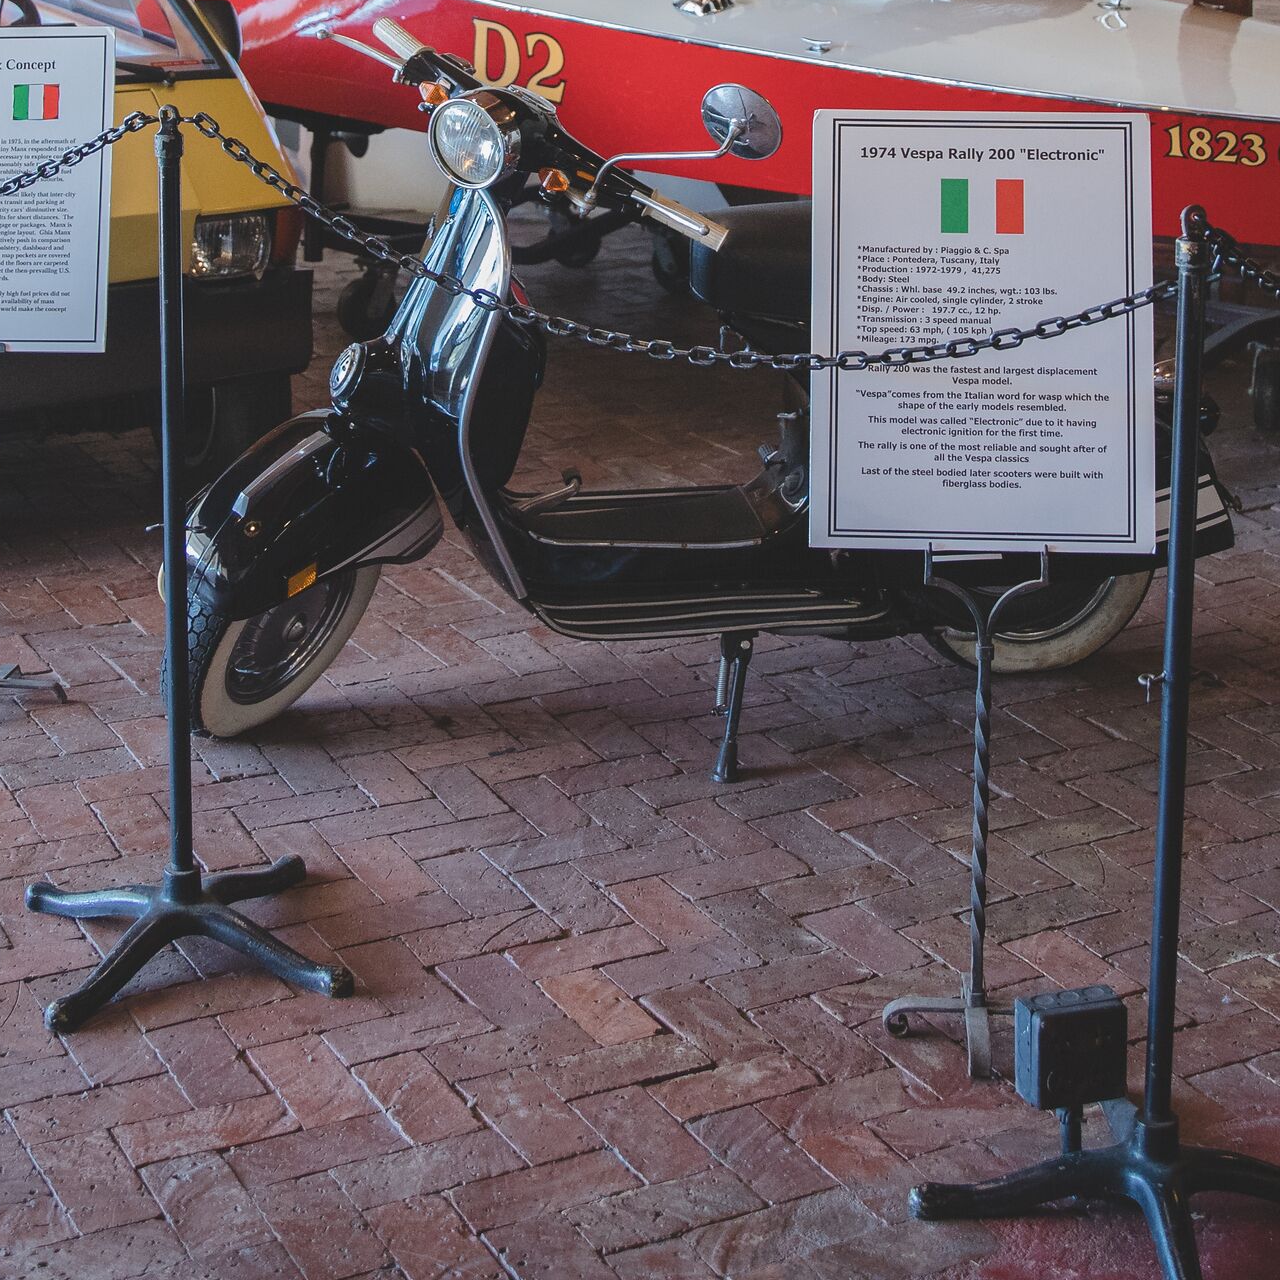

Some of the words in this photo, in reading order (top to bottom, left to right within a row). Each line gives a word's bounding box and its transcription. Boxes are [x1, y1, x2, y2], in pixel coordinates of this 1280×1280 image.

[472, 16, 567, 104] D2
[6, 59, 56, 72] Concept
[1165, 123, 1267, 167] 1823
[860, 147, 897, 158] 1974
[900, 148, 943, 161] Vespa
[948, 148, 984, 162] Rally
[988, 149, 1015, 159] 200
[1020, 149, 1105, 160] "Electronic"
[922, 247, 934, 255] by
[940, 247, 973, 255] Piaggio
[993, 248, 1010, 256] Spa
[892, 256, 938, 264] Pontedera,
[940, 257, 978, 265] Tuscany,
[979, 257, 1000, 265] Italy
[971, 267, 1001, 275] 41,275
[968, 287, 998, 295] inches,
[999, 288, 1022, 296] wgt.:
[909, 296, 940, 304] cooled,
[942, 296, 968, 305] single
[969, 297, 1006, 305] cylinder,
[987, 307, 1001, 315] hp.
[932, 317, 958, 325] speed
[879, 326, 908, 334] speed:
[922, 326, 944, 335] mph,
[971, 327, 987, 335] kph
[918, 337, 939, 345] mpg.
[868, 364, 890, 374] Rally
[893, 364, 910, 373] 200
[1003, 367, 1035, 376] largest
[1036, 367, 1098, 376] displacement
[952, 377, 980, 386] Vespa
[981, 377, 1013, 385] model.
[996, 392, 1020, 400] word
[1038, 394, 1063, 402] wasp
[1064, 393, 1092, 401] which
[889, 416, 917, 424] model
[1066, 419, 1097, 428] having
[901, 427, 947, 435] electronic
[948, 428, 984, 437] ignition
[1018, 429, 1038, 437] first
[882, 467, 893, 475] of
[911, 468, 934, 476] steel
[969, 469, 992, 477] later
[1082, 471, 1104, 479] with
[942, 479, 987, 489] fiberglass
